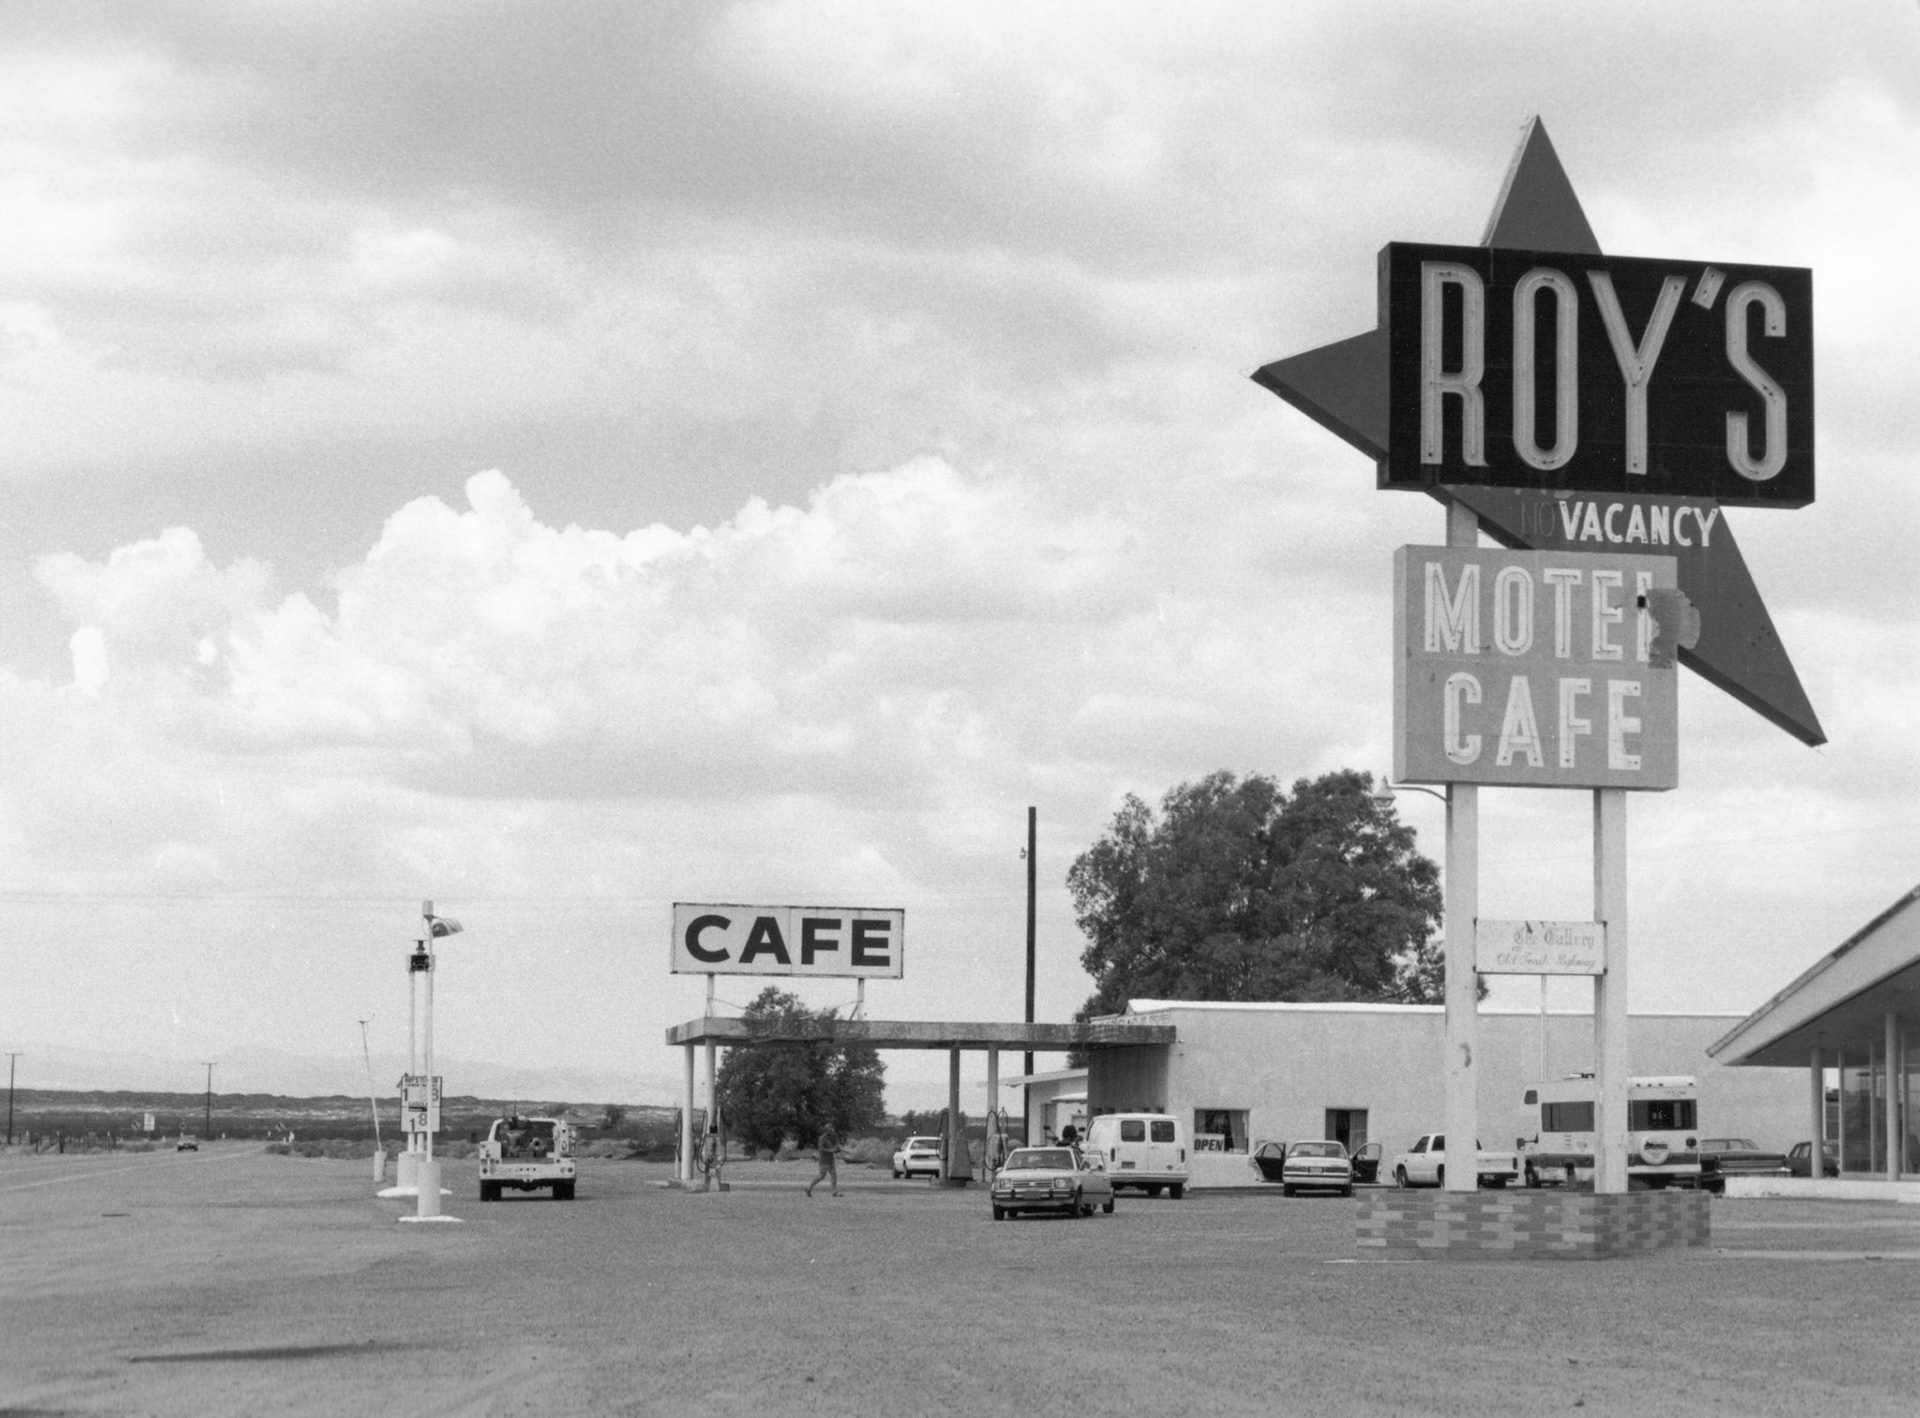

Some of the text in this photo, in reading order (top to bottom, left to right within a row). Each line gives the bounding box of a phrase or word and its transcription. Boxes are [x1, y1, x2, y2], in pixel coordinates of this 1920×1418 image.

[1420, 260, 1787, 482] ROY'S
[1559, 500, 1719, 547] VACANCY
[1444, 672, 1642, 771] CAFE
[685, 914, 891, 967] CAFE
[1194, 1139, 1224, 1151] OPEN
